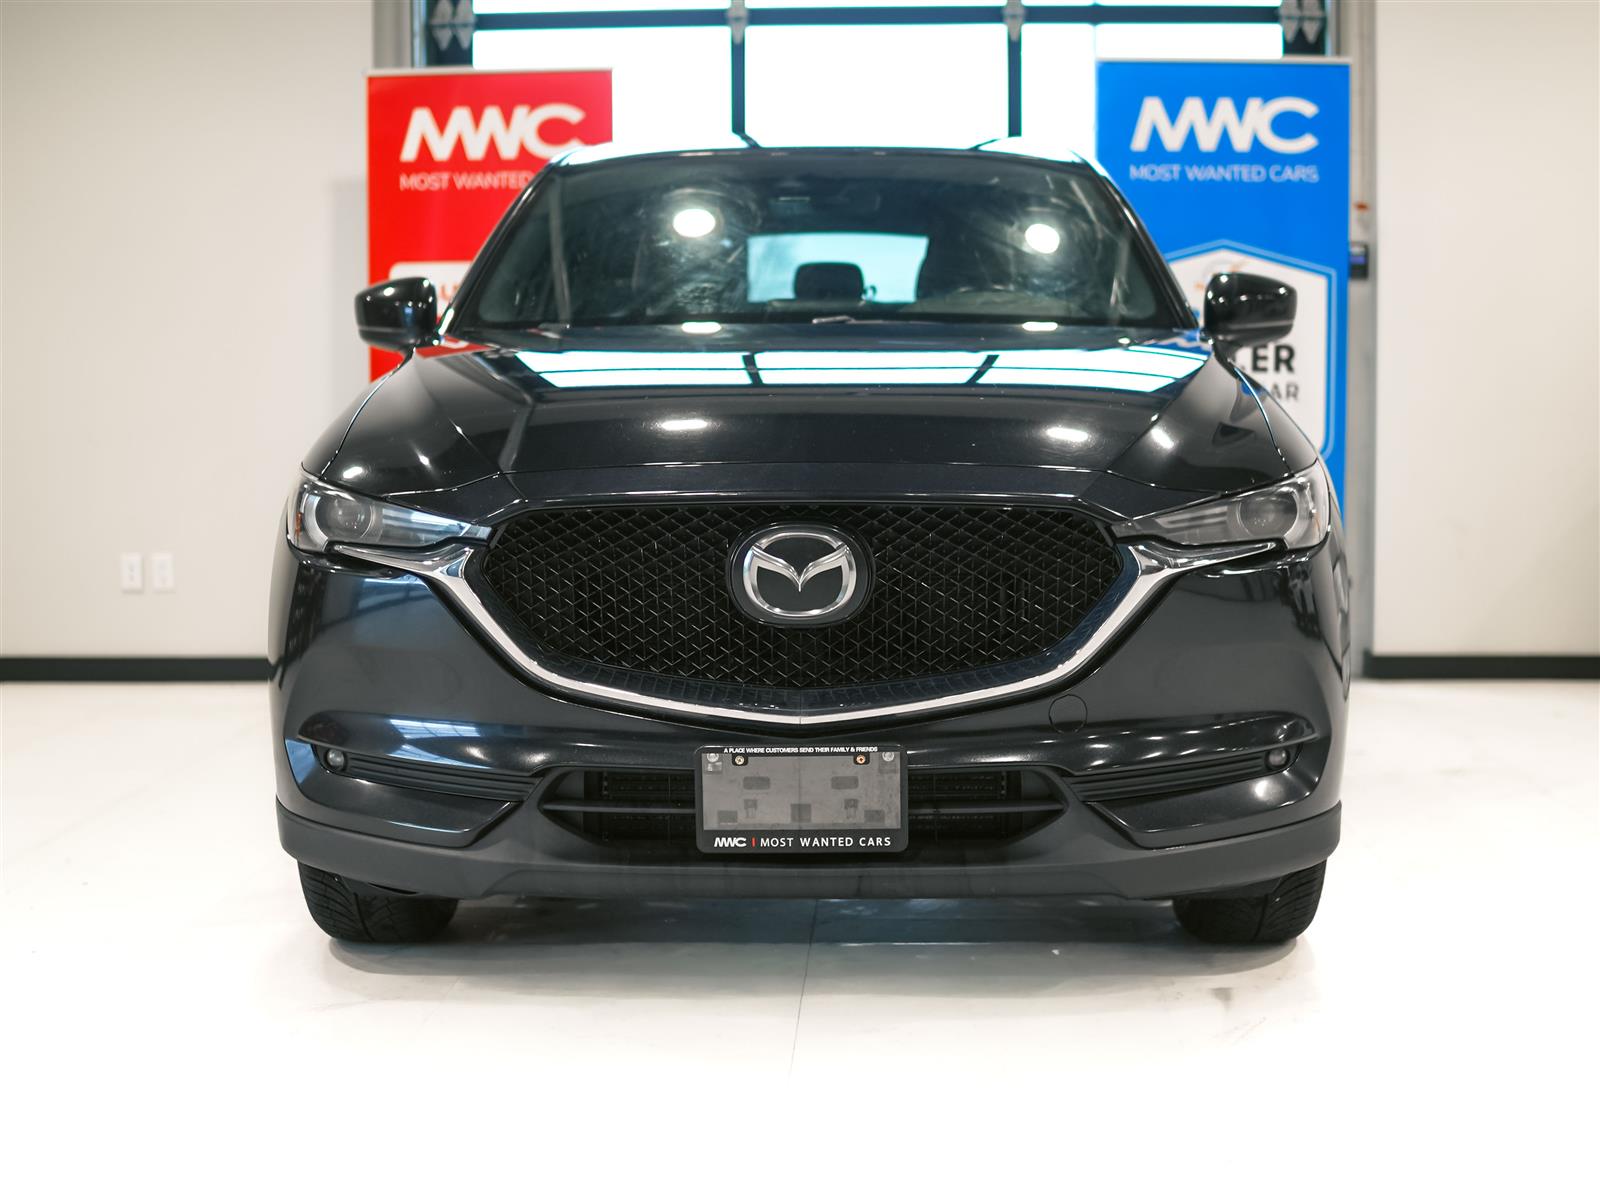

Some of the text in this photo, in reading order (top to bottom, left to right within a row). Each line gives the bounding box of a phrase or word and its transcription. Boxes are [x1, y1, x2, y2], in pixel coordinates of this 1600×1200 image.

[400, 103, 586, 163] MWC
[1130, 96, 1319, 154] MWC
[400, 172, 449, 191] MOST
[1129, 164, 1320, 183] MOST WANTED CARS
[1240, 344, 1295, 373] ER
[714, 837, 891, 848] MWC MOST WANTED CARS
